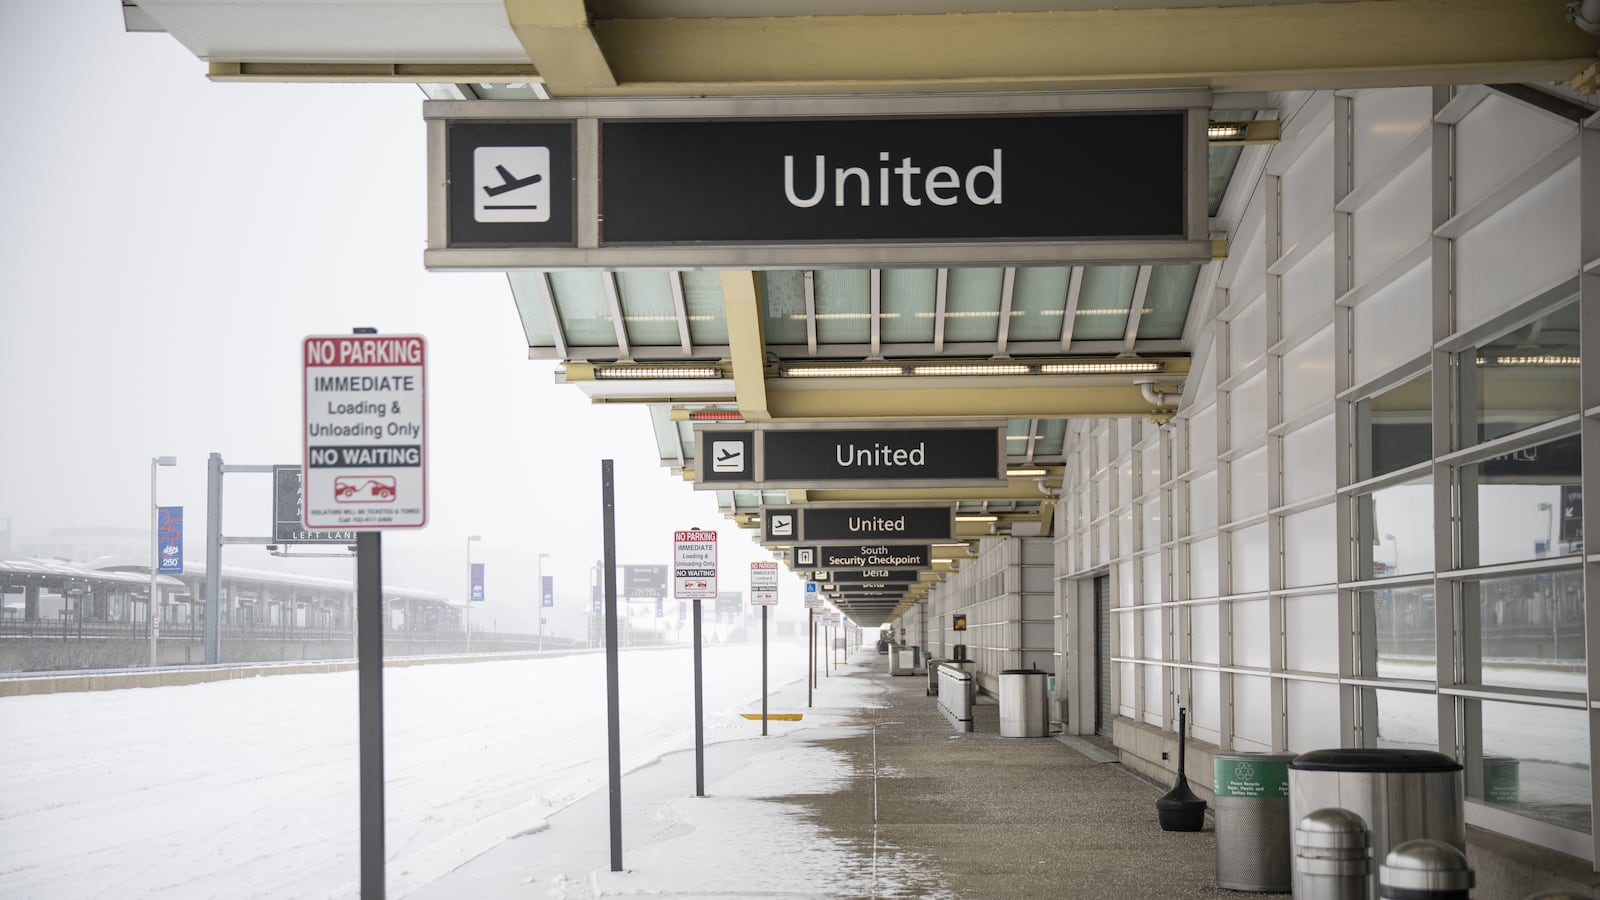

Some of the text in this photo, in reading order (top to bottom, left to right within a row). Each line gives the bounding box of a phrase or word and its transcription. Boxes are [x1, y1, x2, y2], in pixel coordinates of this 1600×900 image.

[782, 148, 1003, 208] United
[308, 340, 422, 364] NO PARKING
[314, 376, 414, 392] IMMEDIATE
[328, 401, 400, 417] Loading &
[310, 422, 420, 439] Unloading Only
[311, 448, 420, 465] NO WAITING
[836, 442, 926, 467] United
[848, 516, 905, 532] United
[676, 532, 716, 541] NO PARKING
[861, 546, 888, 555] South
[162, 558, 178, 566] 250
[830, 556, 920, 566] Security Checkpoint
